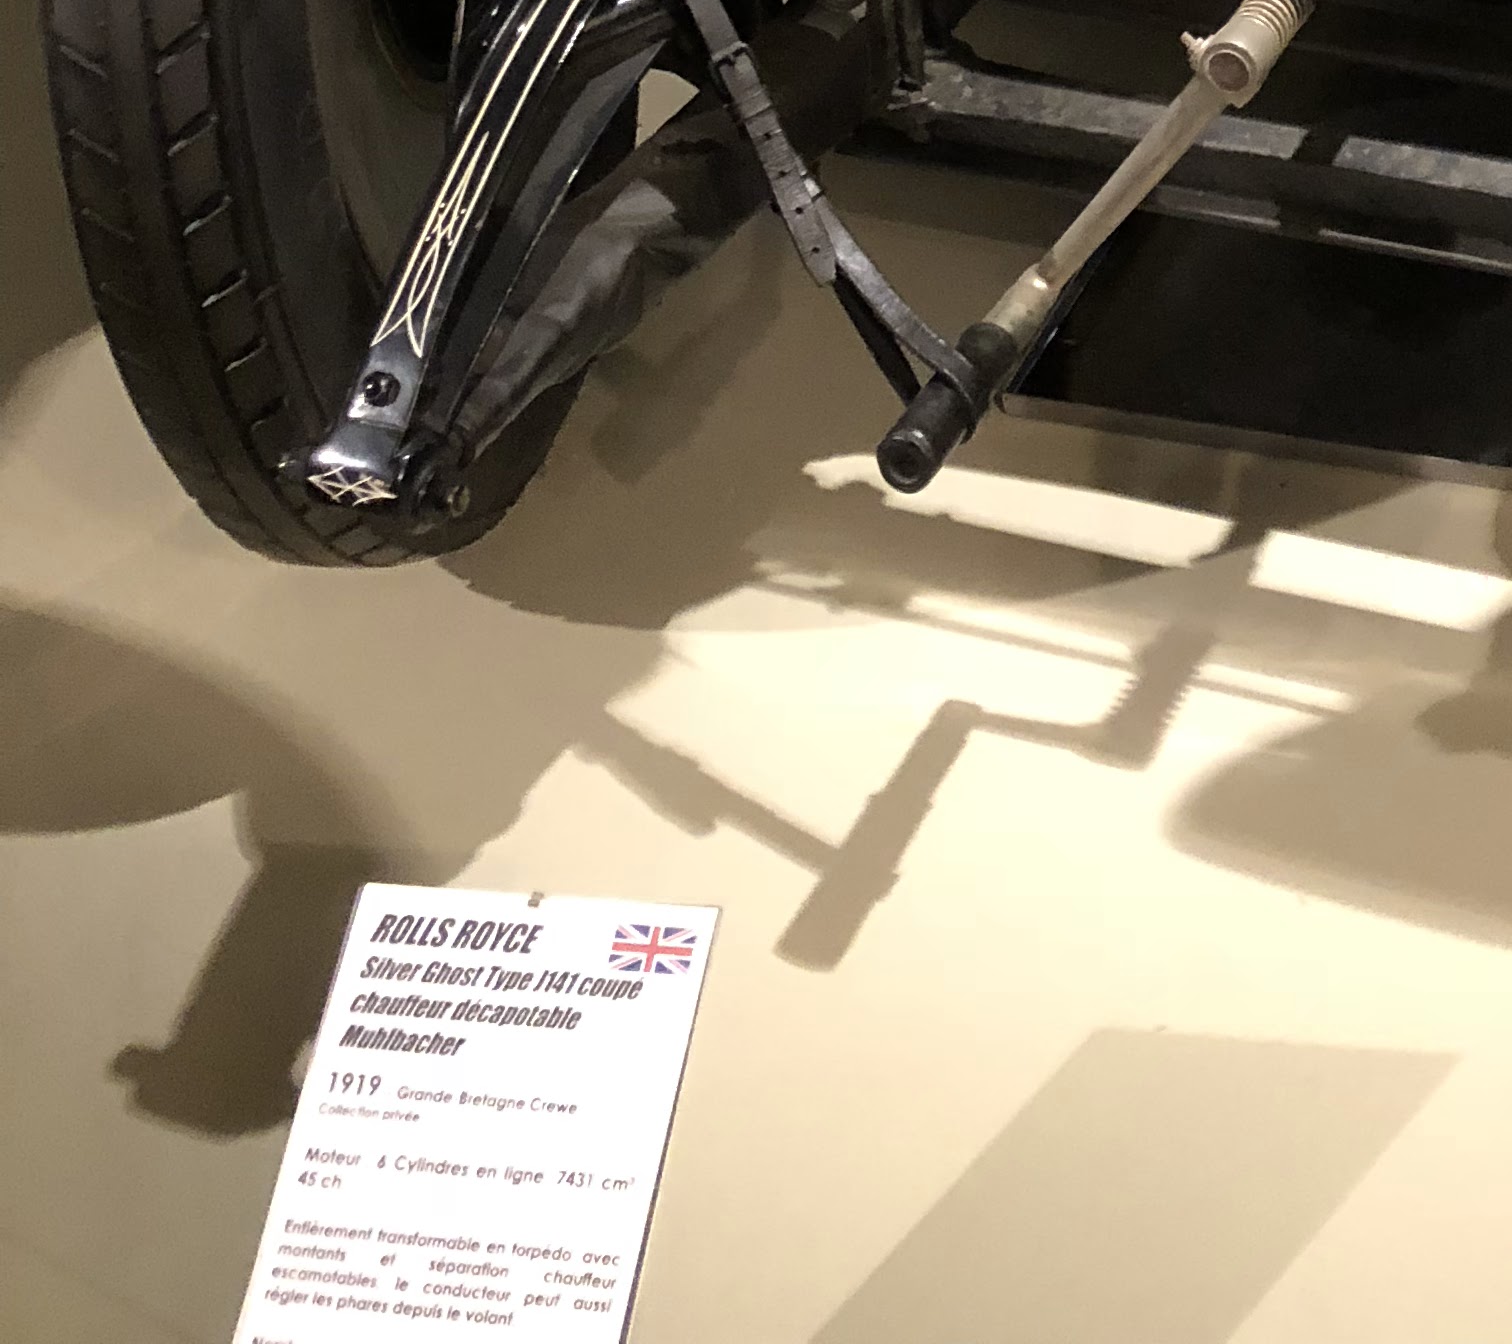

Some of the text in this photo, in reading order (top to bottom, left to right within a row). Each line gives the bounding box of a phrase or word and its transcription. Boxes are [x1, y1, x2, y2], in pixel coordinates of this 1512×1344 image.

[370, 913, 544, 954] ROLLS ROYCE
[360, 956, 422, 982] Silver
[421, 961, 485, 987] Ghost
[484, 965, 533, 992] Type
[577, 976, 644, 1001] coupé
[350, 991, 582, 1030] chauffeur décapotable
[339, 1024, 466, 1056] Muhlbacher
[319, 1102, 420, 1123] Collection privée
[329, 1072, 577, 1114] 1919 Grande Bretagne Crewe
[297, 1169, 342, 1190] 45 ch
[305, 1147, 361, 1166] Moteur
[377, 1155, 387, 1169] 6
[394, 1155, 468, 1177] Cylindres
[476, 1165, 496, 1178] en
[503, 1166, 544, 1185] ligne
[557, 1170, 593, 1188] 7431
[284, 1218, 620, 1267] Entièrement transformable en torpédo avec
[278, 1244, 617, 1290] montants et séparation chauffeur
[264, 1286, 514, 1326] régler les phares depuis le volant
[394, 1276, 409, 1291] le
[423, 1282, 511, 1302] conducteur
[523, 1292, 561, 1307] peut
[573, 1298, 613, 1313] aussi
